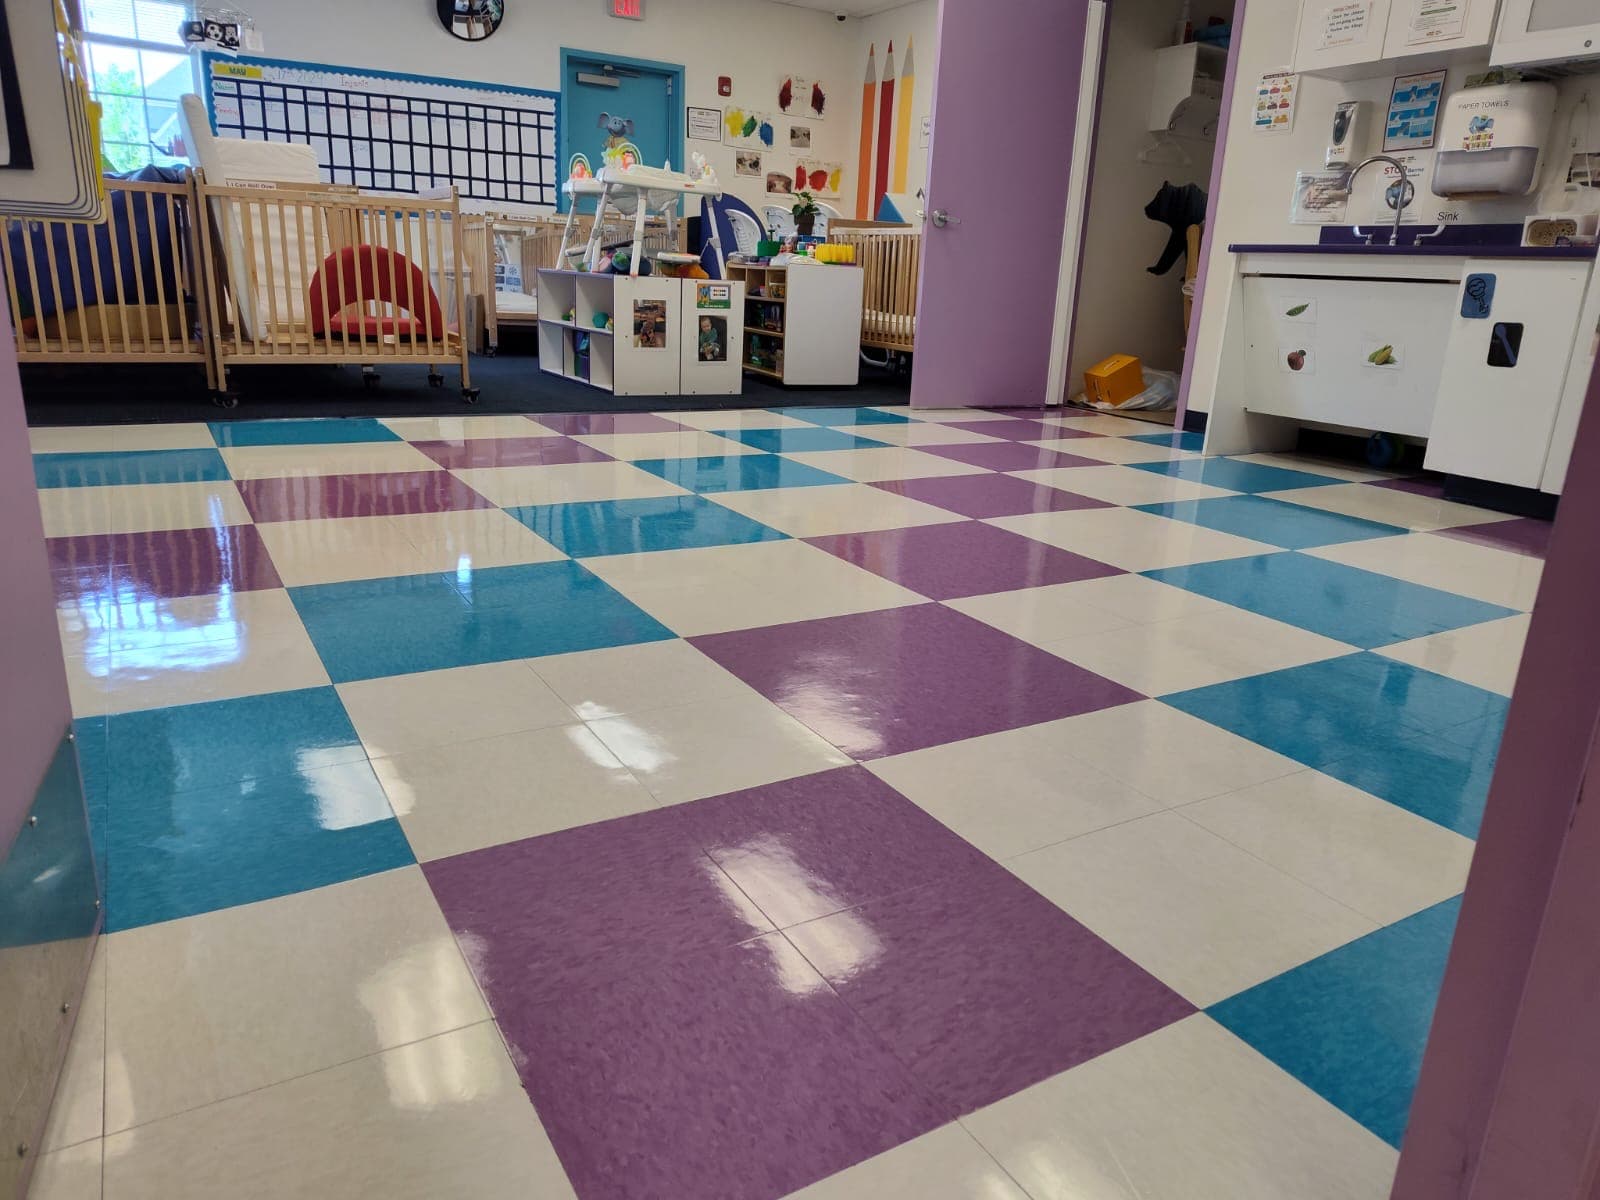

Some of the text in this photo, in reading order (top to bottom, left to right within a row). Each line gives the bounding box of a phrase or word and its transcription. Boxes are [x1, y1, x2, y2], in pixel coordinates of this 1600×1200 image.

[1458, 99, 1510, 110] PAPER TOWELS
[1437, 210, 1460, 222] Sink
